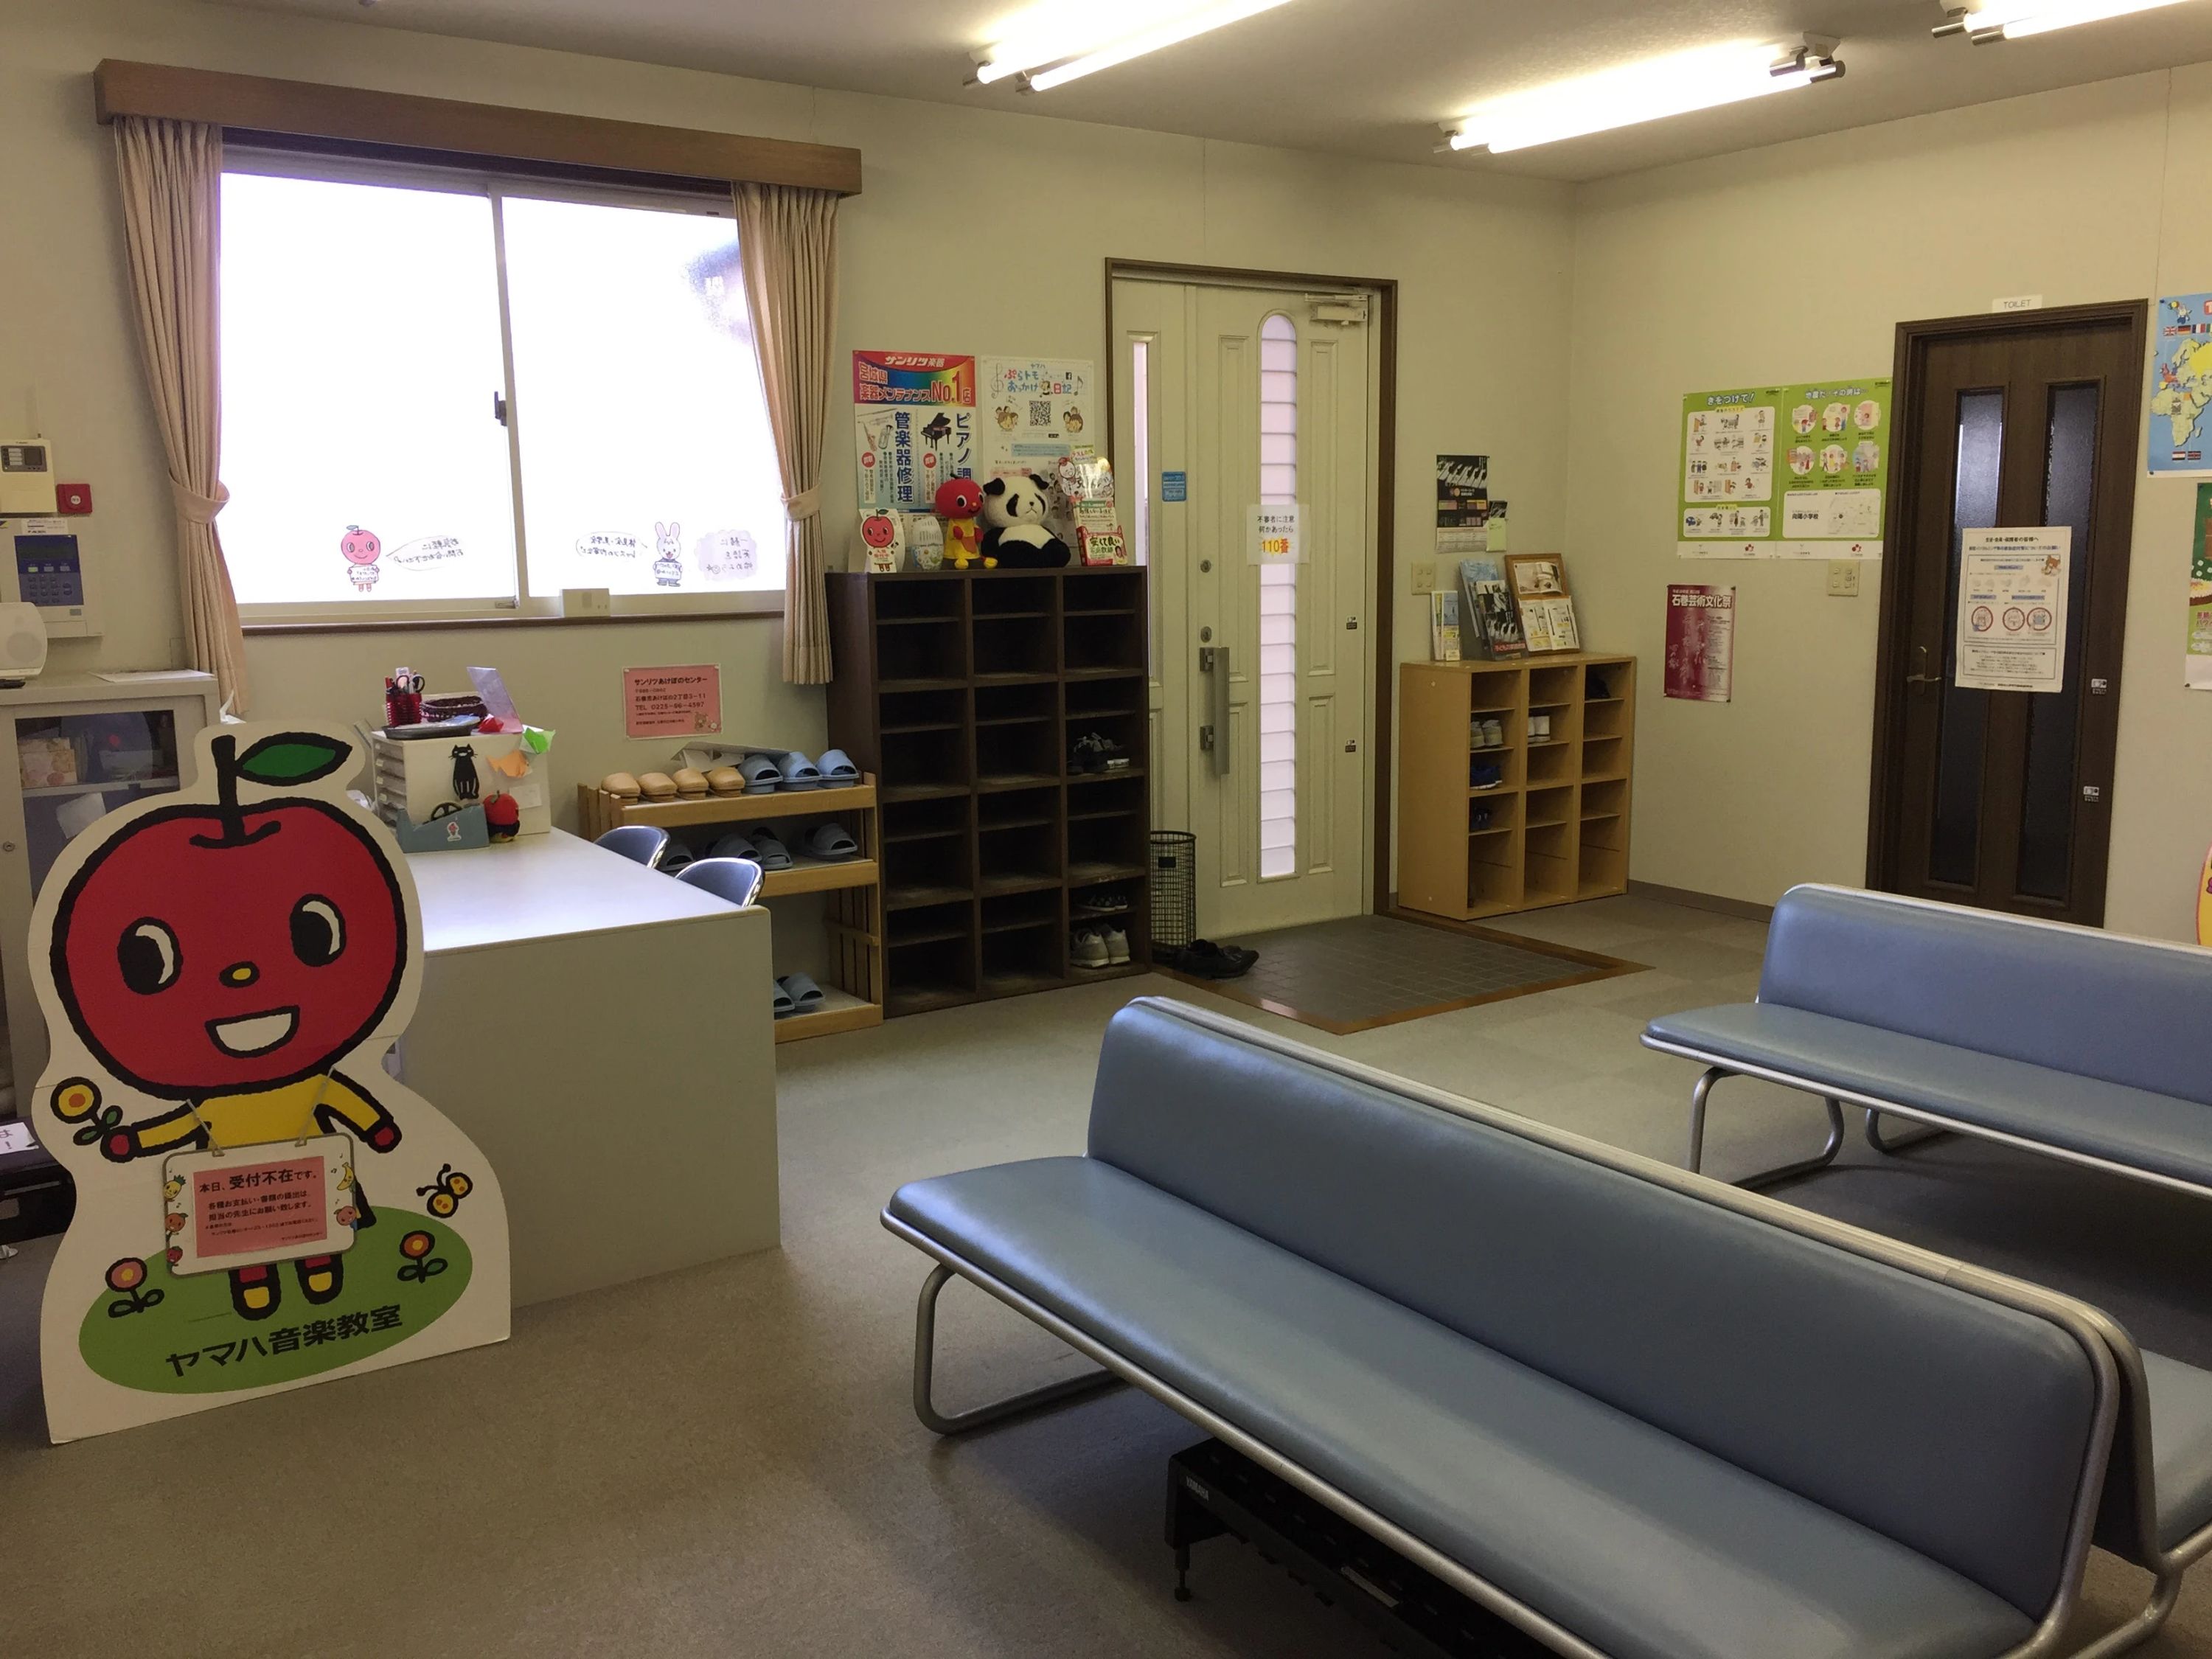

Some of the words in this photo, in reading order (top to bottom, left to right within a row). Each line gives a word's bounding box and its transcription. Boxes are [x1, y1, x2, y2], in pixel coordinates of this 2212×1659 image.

[2003, 299, 2031, 308] TOILET
[885, 355, 945, 367] サンリツ楽器
[1054, 383, 1071, 394] 日記
[895, 411, 914, 502] 管楽器修理
[1257, 515, 1295, 524] 不審者に注意
[1259, 526, 1294, 534] 何かあったら
[1262, 538, 1289, 554] 110番
[1672, 594, 1732, 609] 石巻芸術文化祭
[635, 677, 708, 686] サンリツあけぼのセンター
[199, 1169, 317, 1193] 本日、受付不在です。
[165, 1304, 403, 1377] ヤマハ音楽教室
